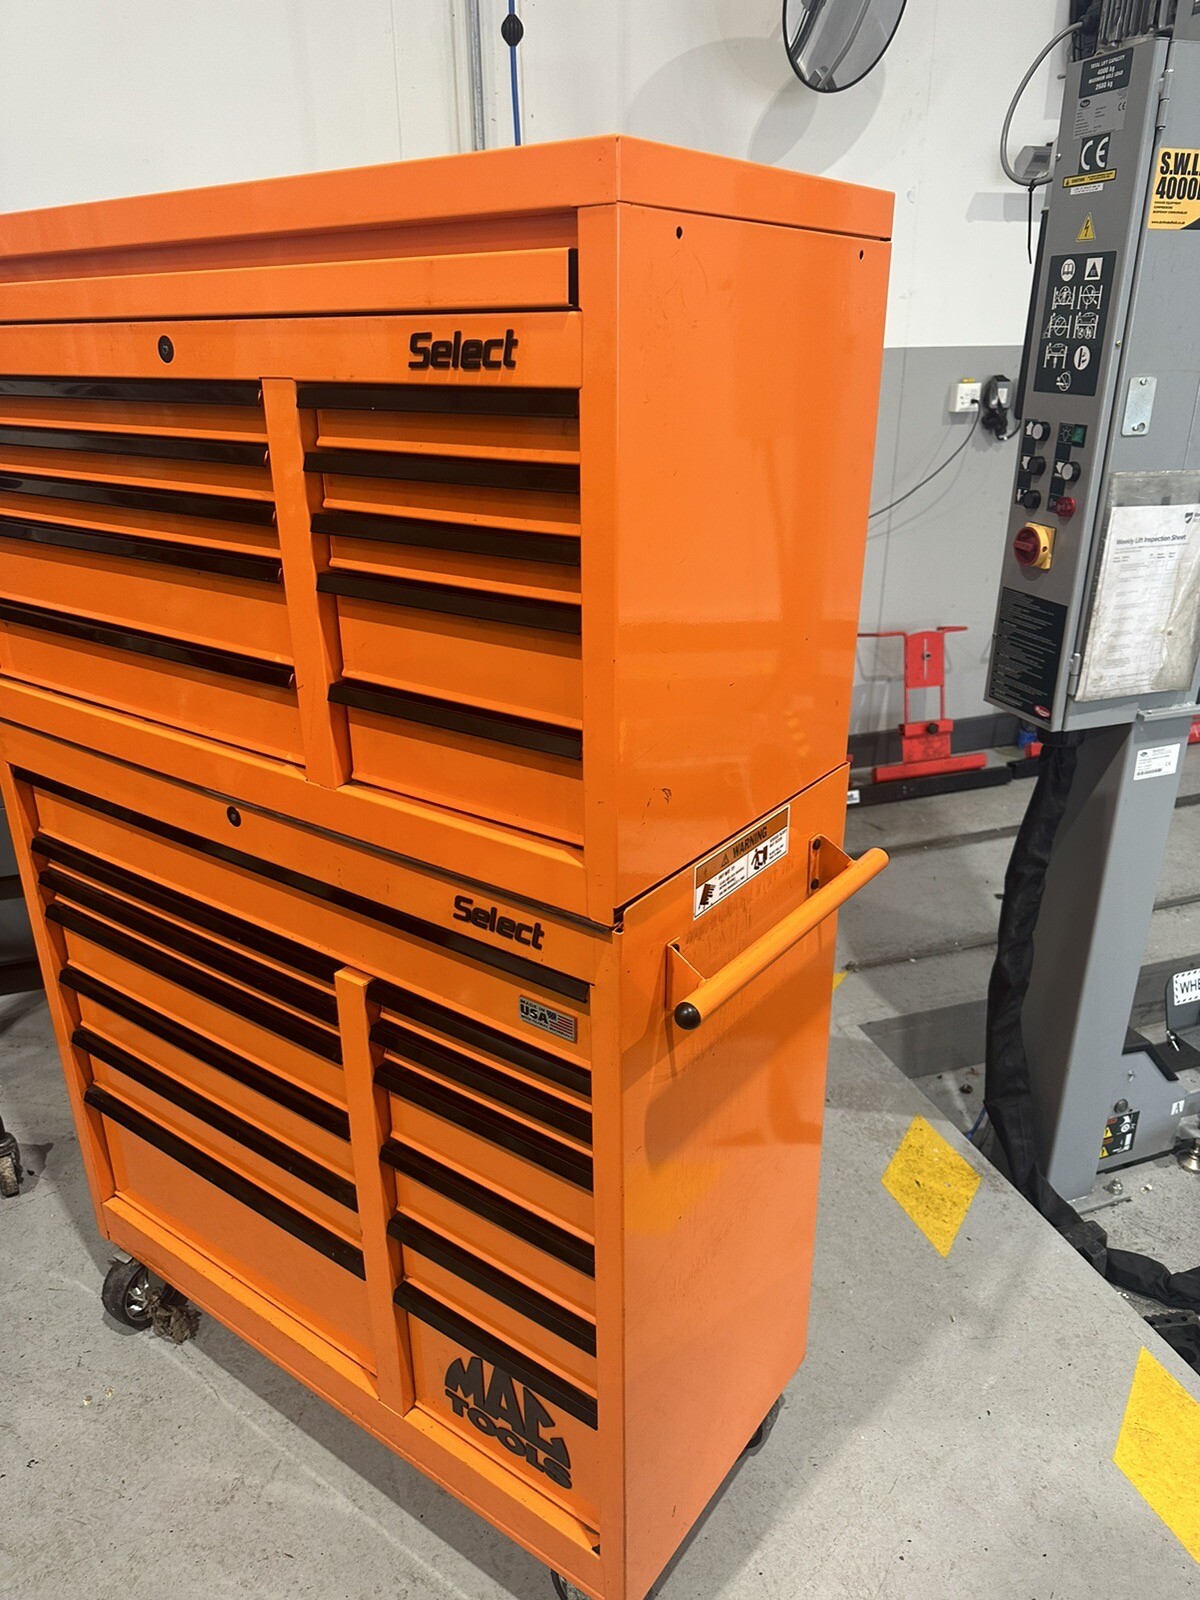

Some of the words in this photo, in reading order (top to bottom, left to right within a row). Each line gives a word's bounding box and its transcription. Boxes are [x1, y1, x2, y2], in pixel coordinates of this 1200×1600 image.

[1081, 136, 1109, 170] CE
[408, 328, 519, 370] Select
[1144, 536, 1170, 544] Inspection
[732, 826, 767, 858] WARNING
[453, 895, 545, 950] Select
[520, 998, 537, 1009] MADE
[520, 1003, 549, 1025] USA
[444, 1356, 571, 1469] MAC
[444, 1388, 572, 1489] TOOLS
